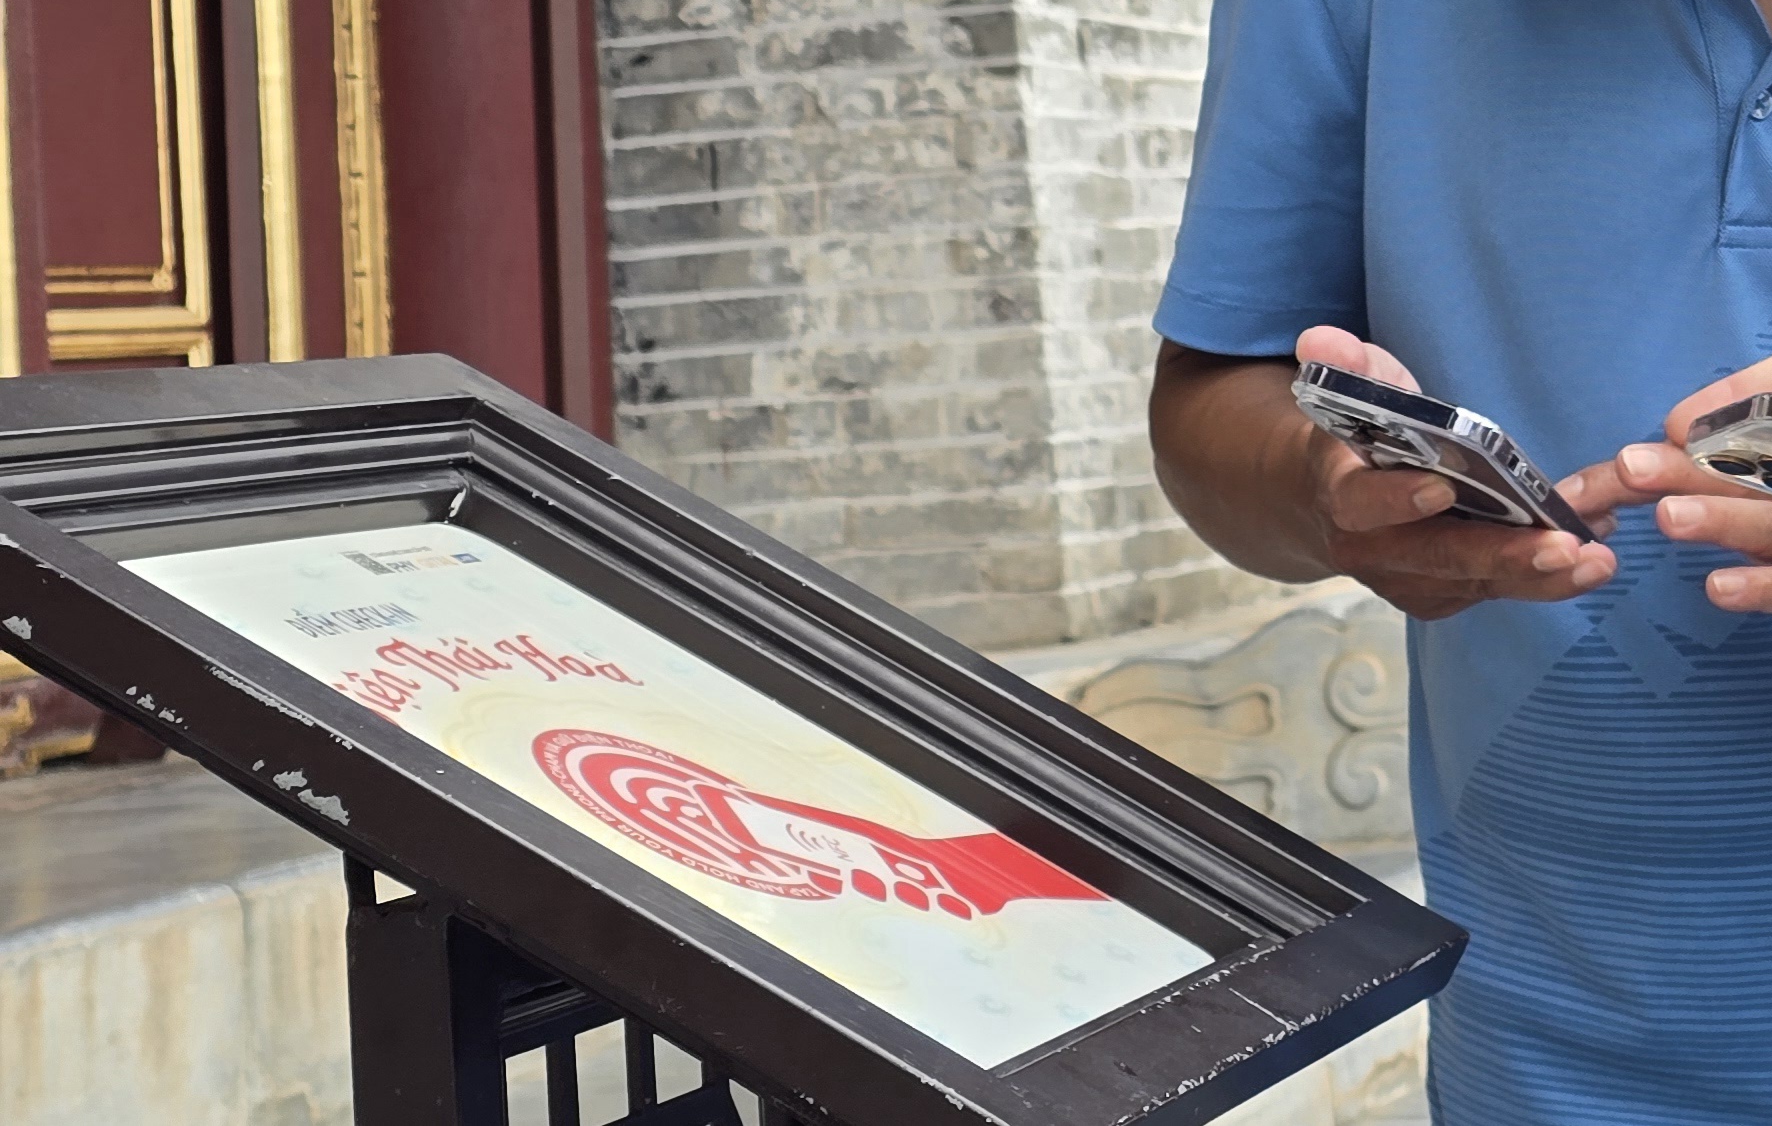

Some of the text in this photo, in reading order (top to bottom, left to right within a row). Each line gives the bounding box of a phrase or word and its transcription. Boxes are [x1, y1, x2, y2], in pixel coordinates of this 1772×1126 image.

[330, 602, 422, 631] CHECK-IN
[333, 634, 645, 725] iện Thái Hoà
[560, 781, 617, 823] PHONE
[617, 824, 675, 858] YOUR
[820, 834, 855, 863] NFC
[681, 856, 741, 884] HOLD
[745, 879, 785, 895] AND
